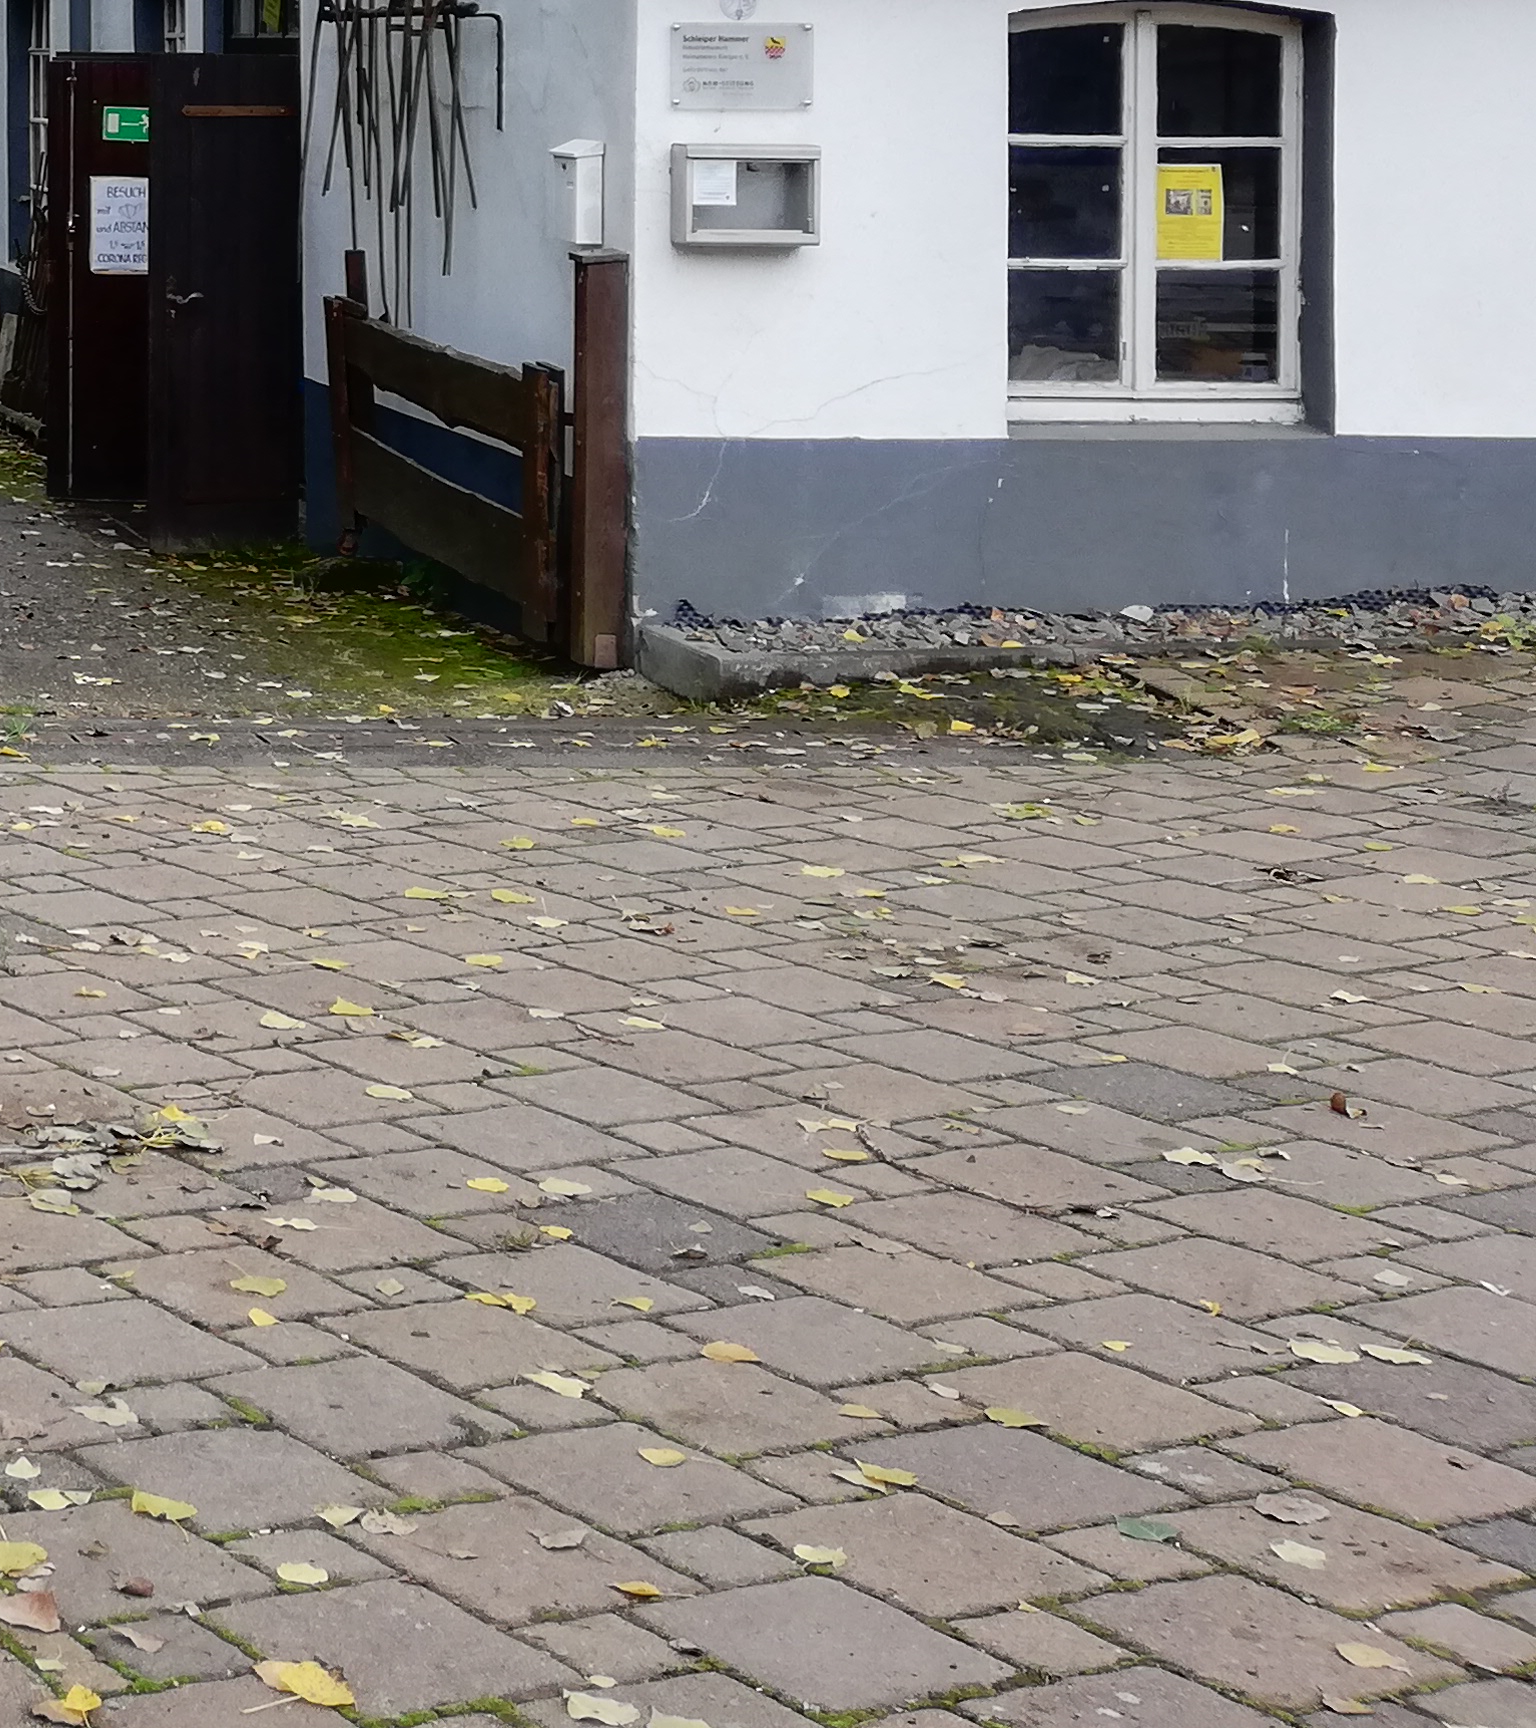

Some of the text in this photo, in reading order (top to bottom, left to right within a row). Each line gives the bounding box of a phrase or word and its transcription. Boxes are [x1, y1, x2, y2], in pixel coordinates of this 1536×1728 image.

[683, 35, 716, 43] Schleiper
[106, 186, 146, 198] BESUCH
[97, 254, 131, 263] CORONA
